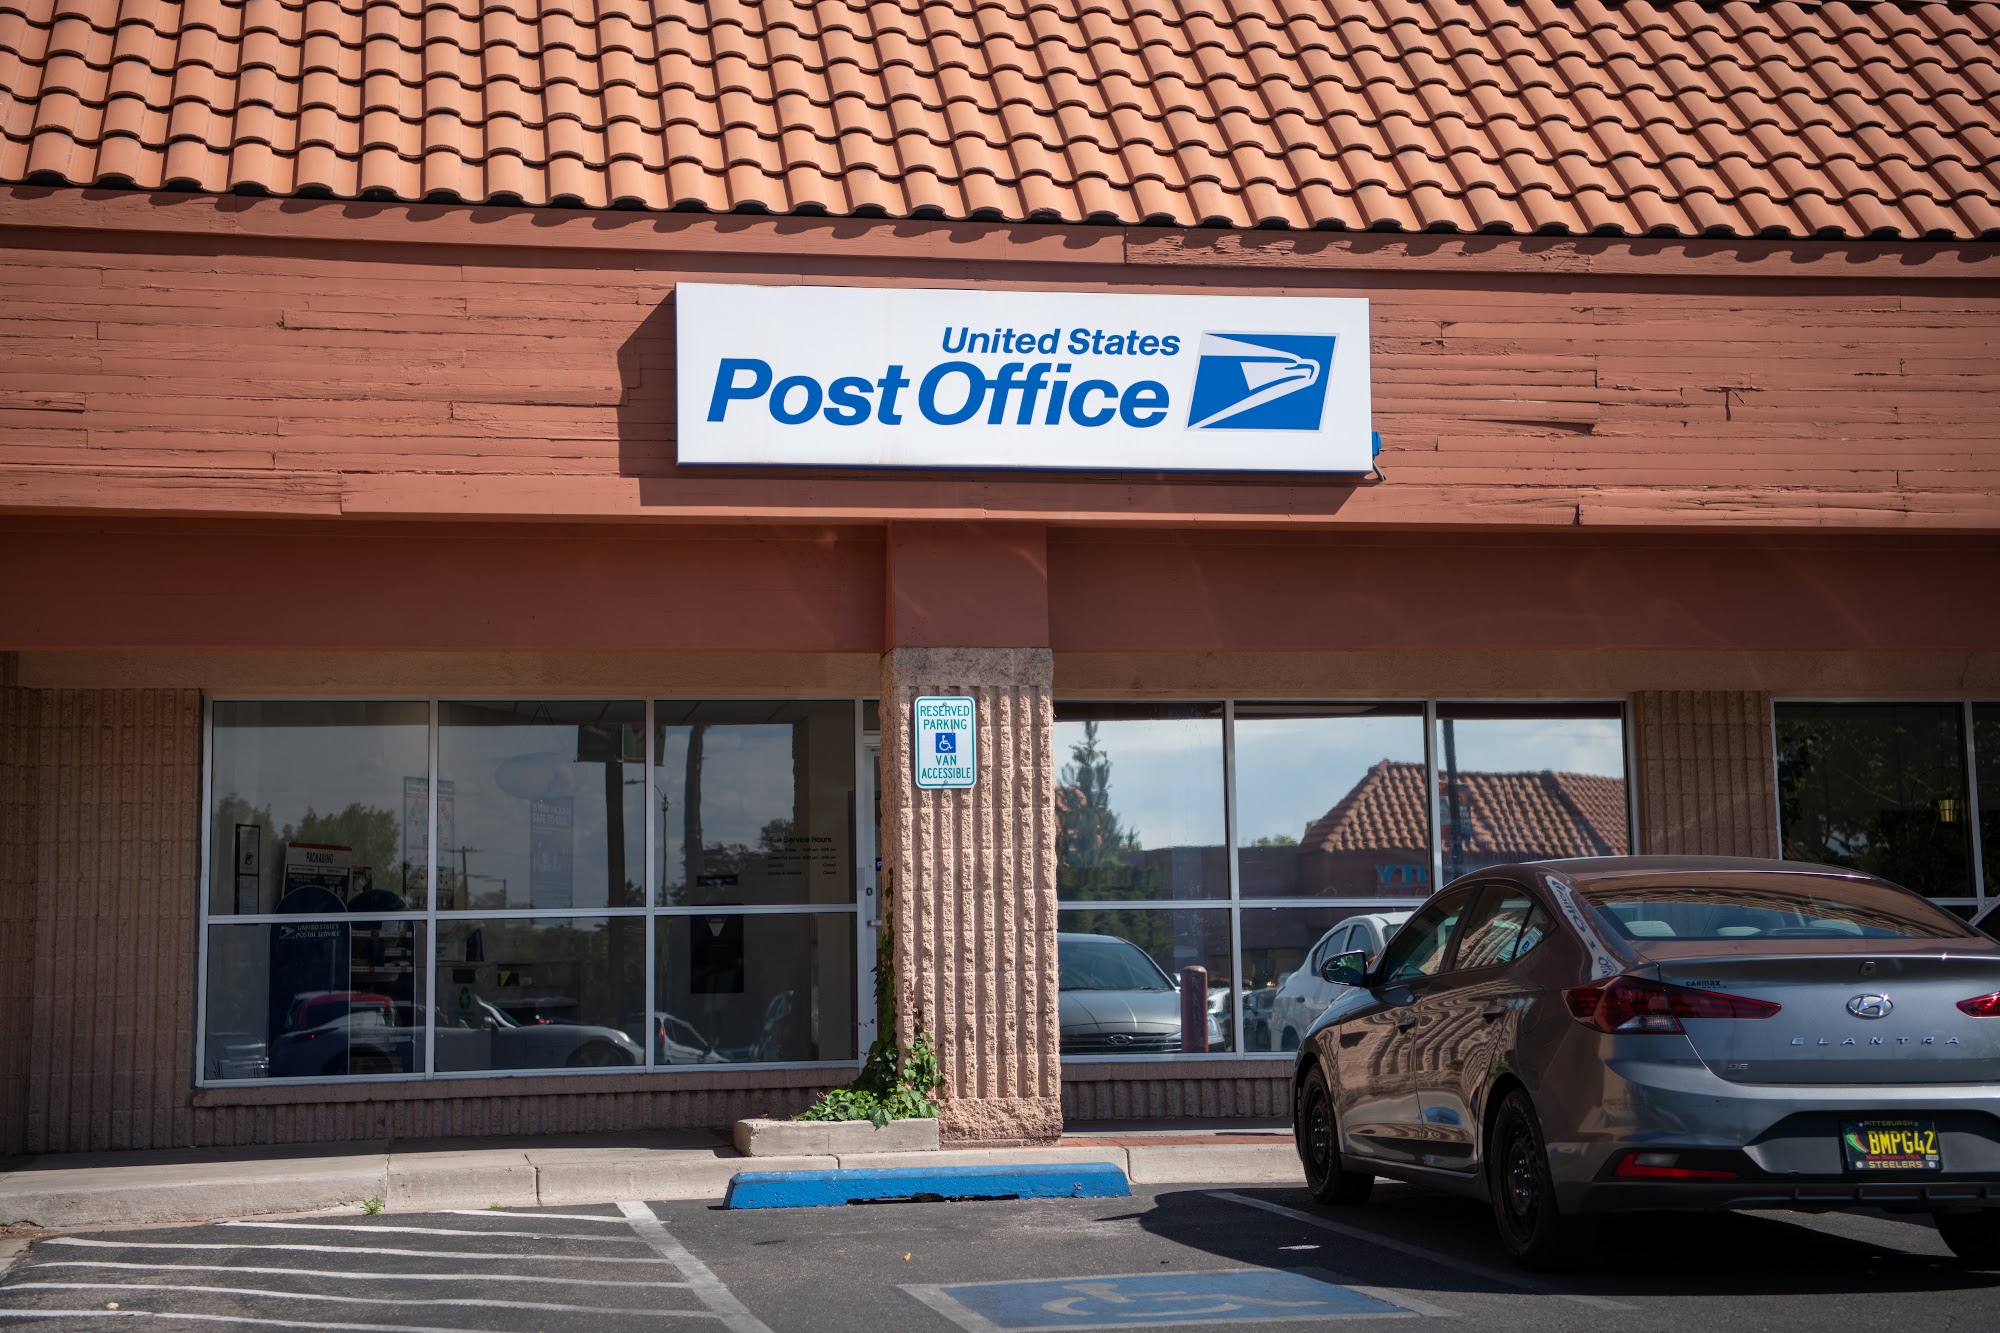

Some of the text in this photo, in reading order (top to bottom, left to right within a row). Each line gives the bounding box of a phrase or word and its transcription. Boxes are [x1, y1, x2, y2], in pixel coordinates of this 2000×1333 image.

[941, 326, 1180, 357] United States
[707, 358, 1169, 428] Post Office
[920, 705, 970, 717] RESERVED
[923, 719, 967, 730] PARKING
[935, 755, 957, 766] VAN
[921, 767, 971, 779] ACCESSIBLE
[306, 852, 334, 864] PACKAGING
[1790, 1036, 1960, 1046] ELANTRA
[1867, 1130, 1937, 1155] BMPG42
[1869, 1160, 1923, 1169] STEELERS
